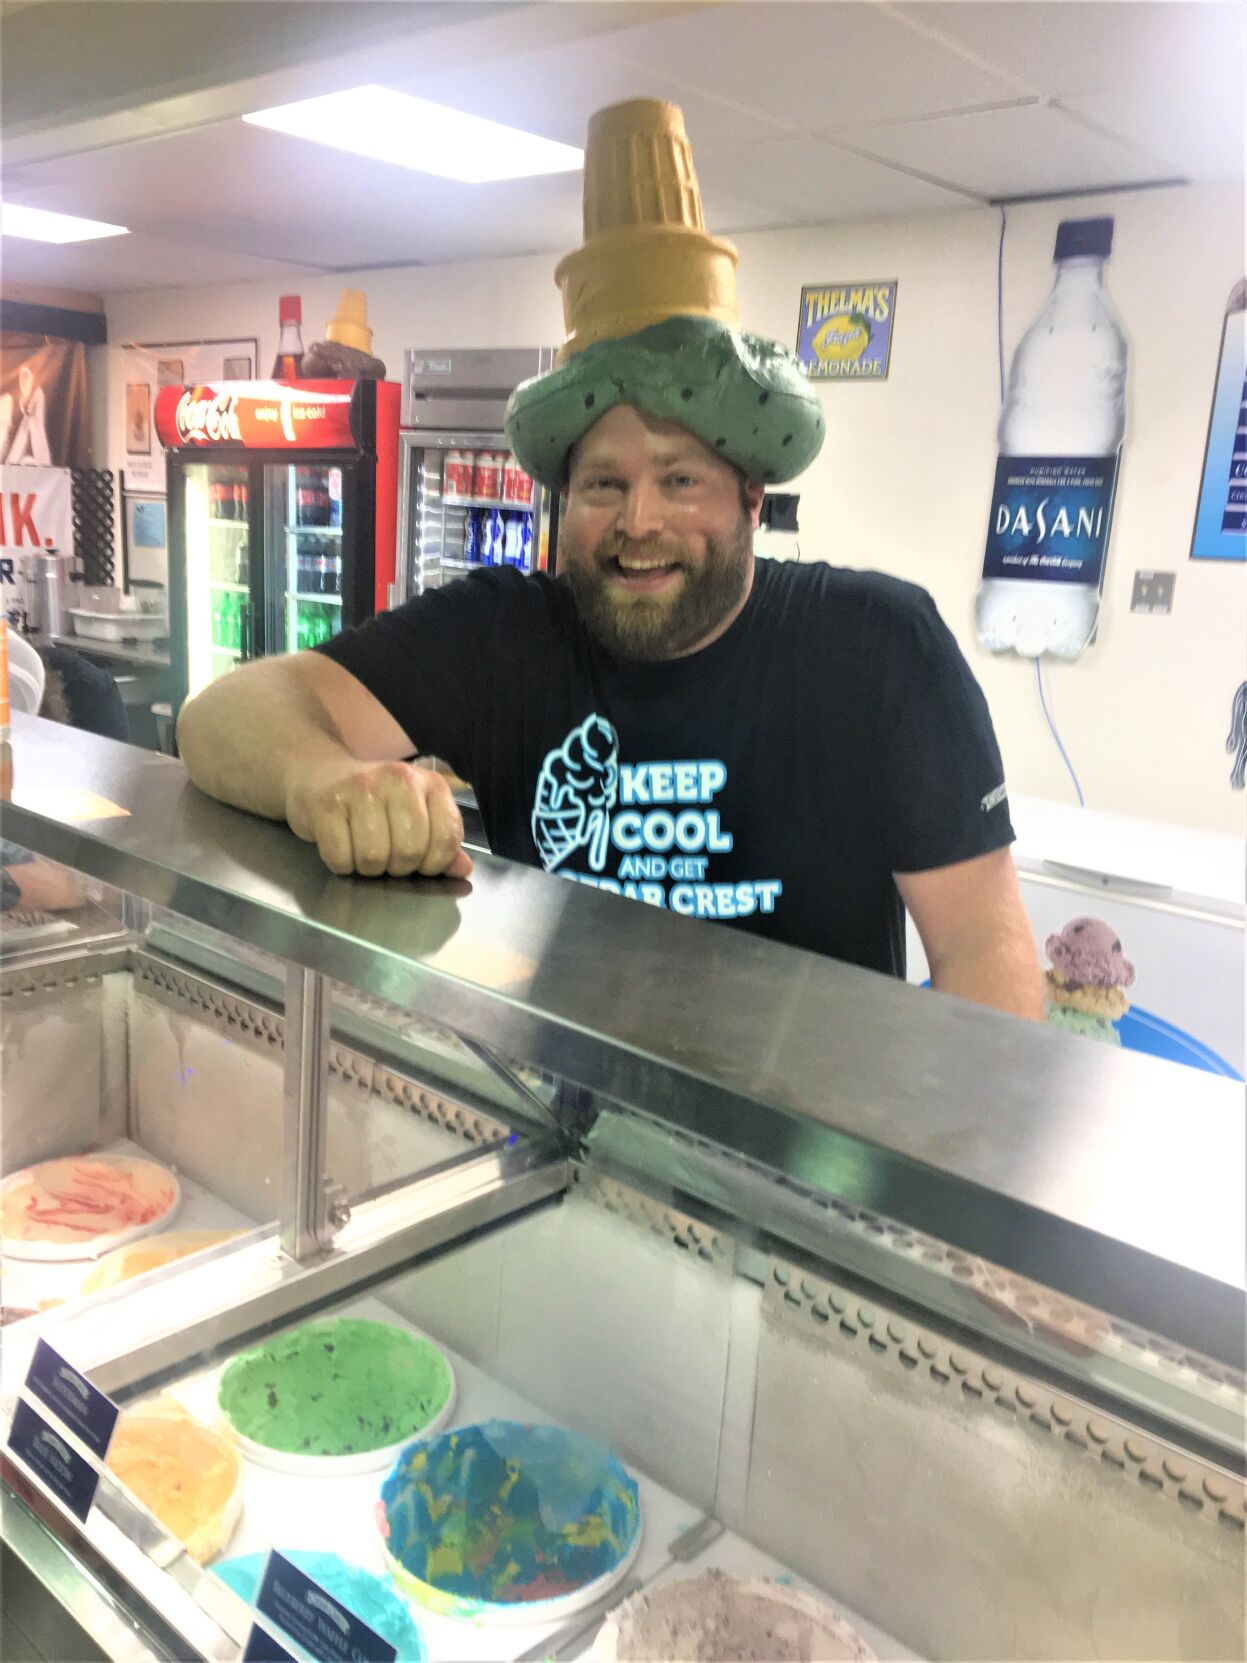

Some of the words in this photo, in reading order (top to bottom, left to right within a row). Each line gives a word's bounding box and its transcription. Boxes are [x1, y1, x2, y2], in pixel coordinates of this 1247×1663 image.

[805, 286, 890, 330] THELMA'S
[996, 496, 1104, 545] DASANI
[619, 759, 728, 804] KEEP
[610, 809, 733, 853] COOL
[617, 854, 667, 880] AND
[668, 854, 709, 881] GET
[669, 879, 783, 919] CREST
